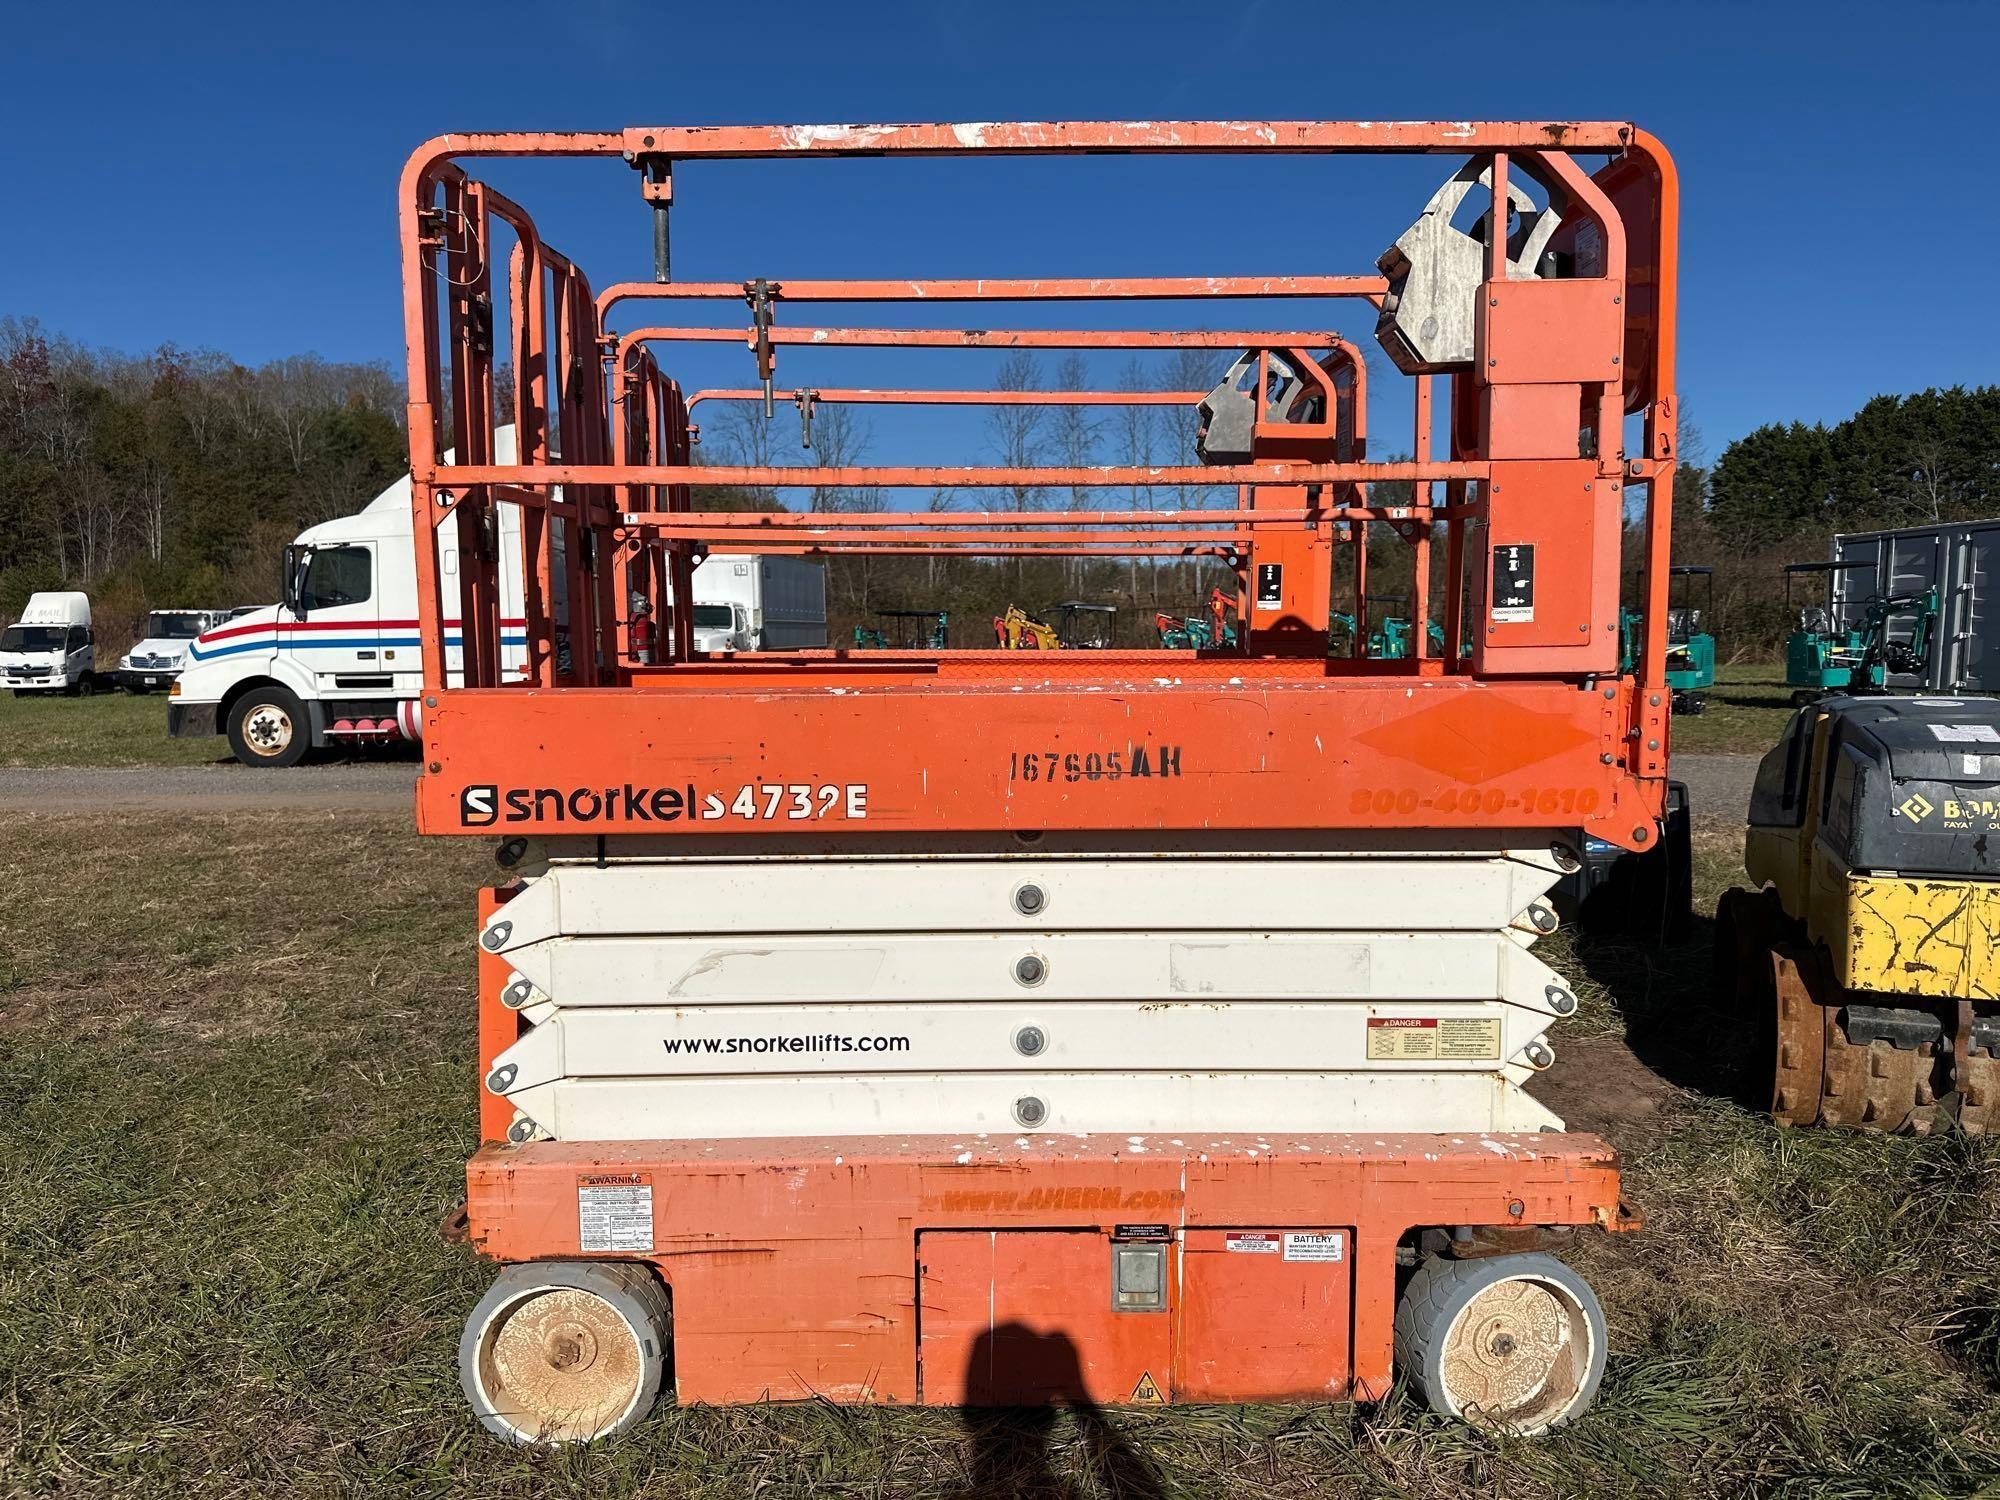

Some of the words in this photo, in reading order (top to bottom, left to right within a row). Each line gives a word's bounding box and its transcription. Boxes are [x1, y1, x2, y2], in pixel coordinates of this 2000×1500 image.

[505, 784, 696, 821] snorkel
[1349, 788, 1599, 815] 800-400-1610
[663, 1034, 910, 1054] www.snorkellifts.com
[596, 1176, 642, 1184] WARNING
[1293, 1235, 1332, 1243] BATTERY
